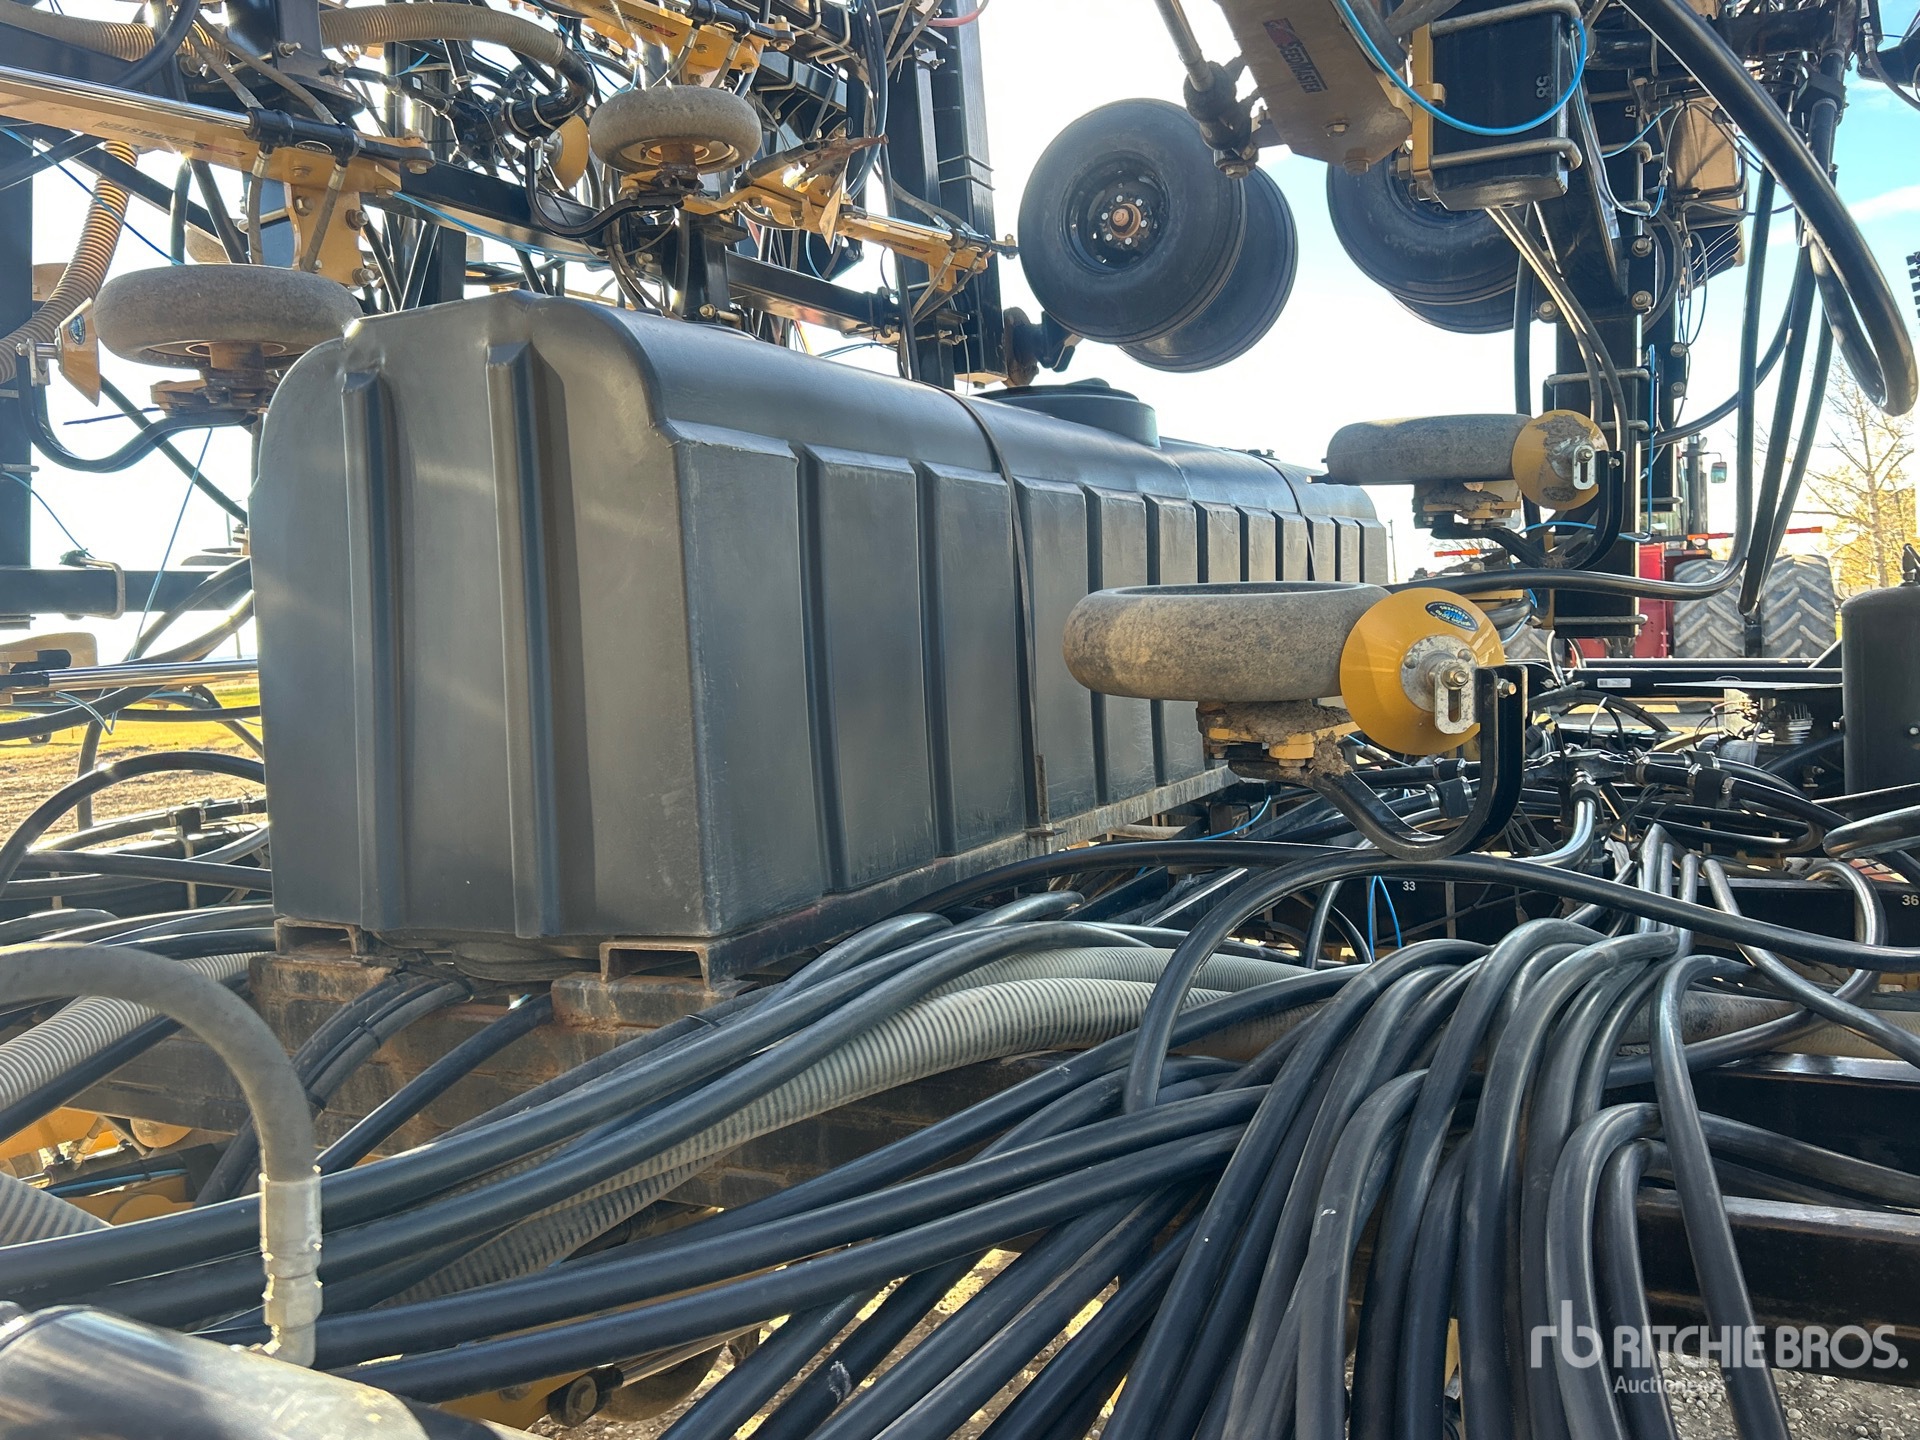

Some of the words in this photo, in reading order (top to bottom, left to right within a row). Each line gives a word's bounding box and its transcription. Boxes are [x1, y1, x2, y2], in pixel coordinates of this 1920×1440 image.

[1535, 74, 1553, 99] 58
[1625, 104, 1637, 118] 57
[1402, 880, 1416, 891] 33
[1902, 894, 1919, 906] 36
